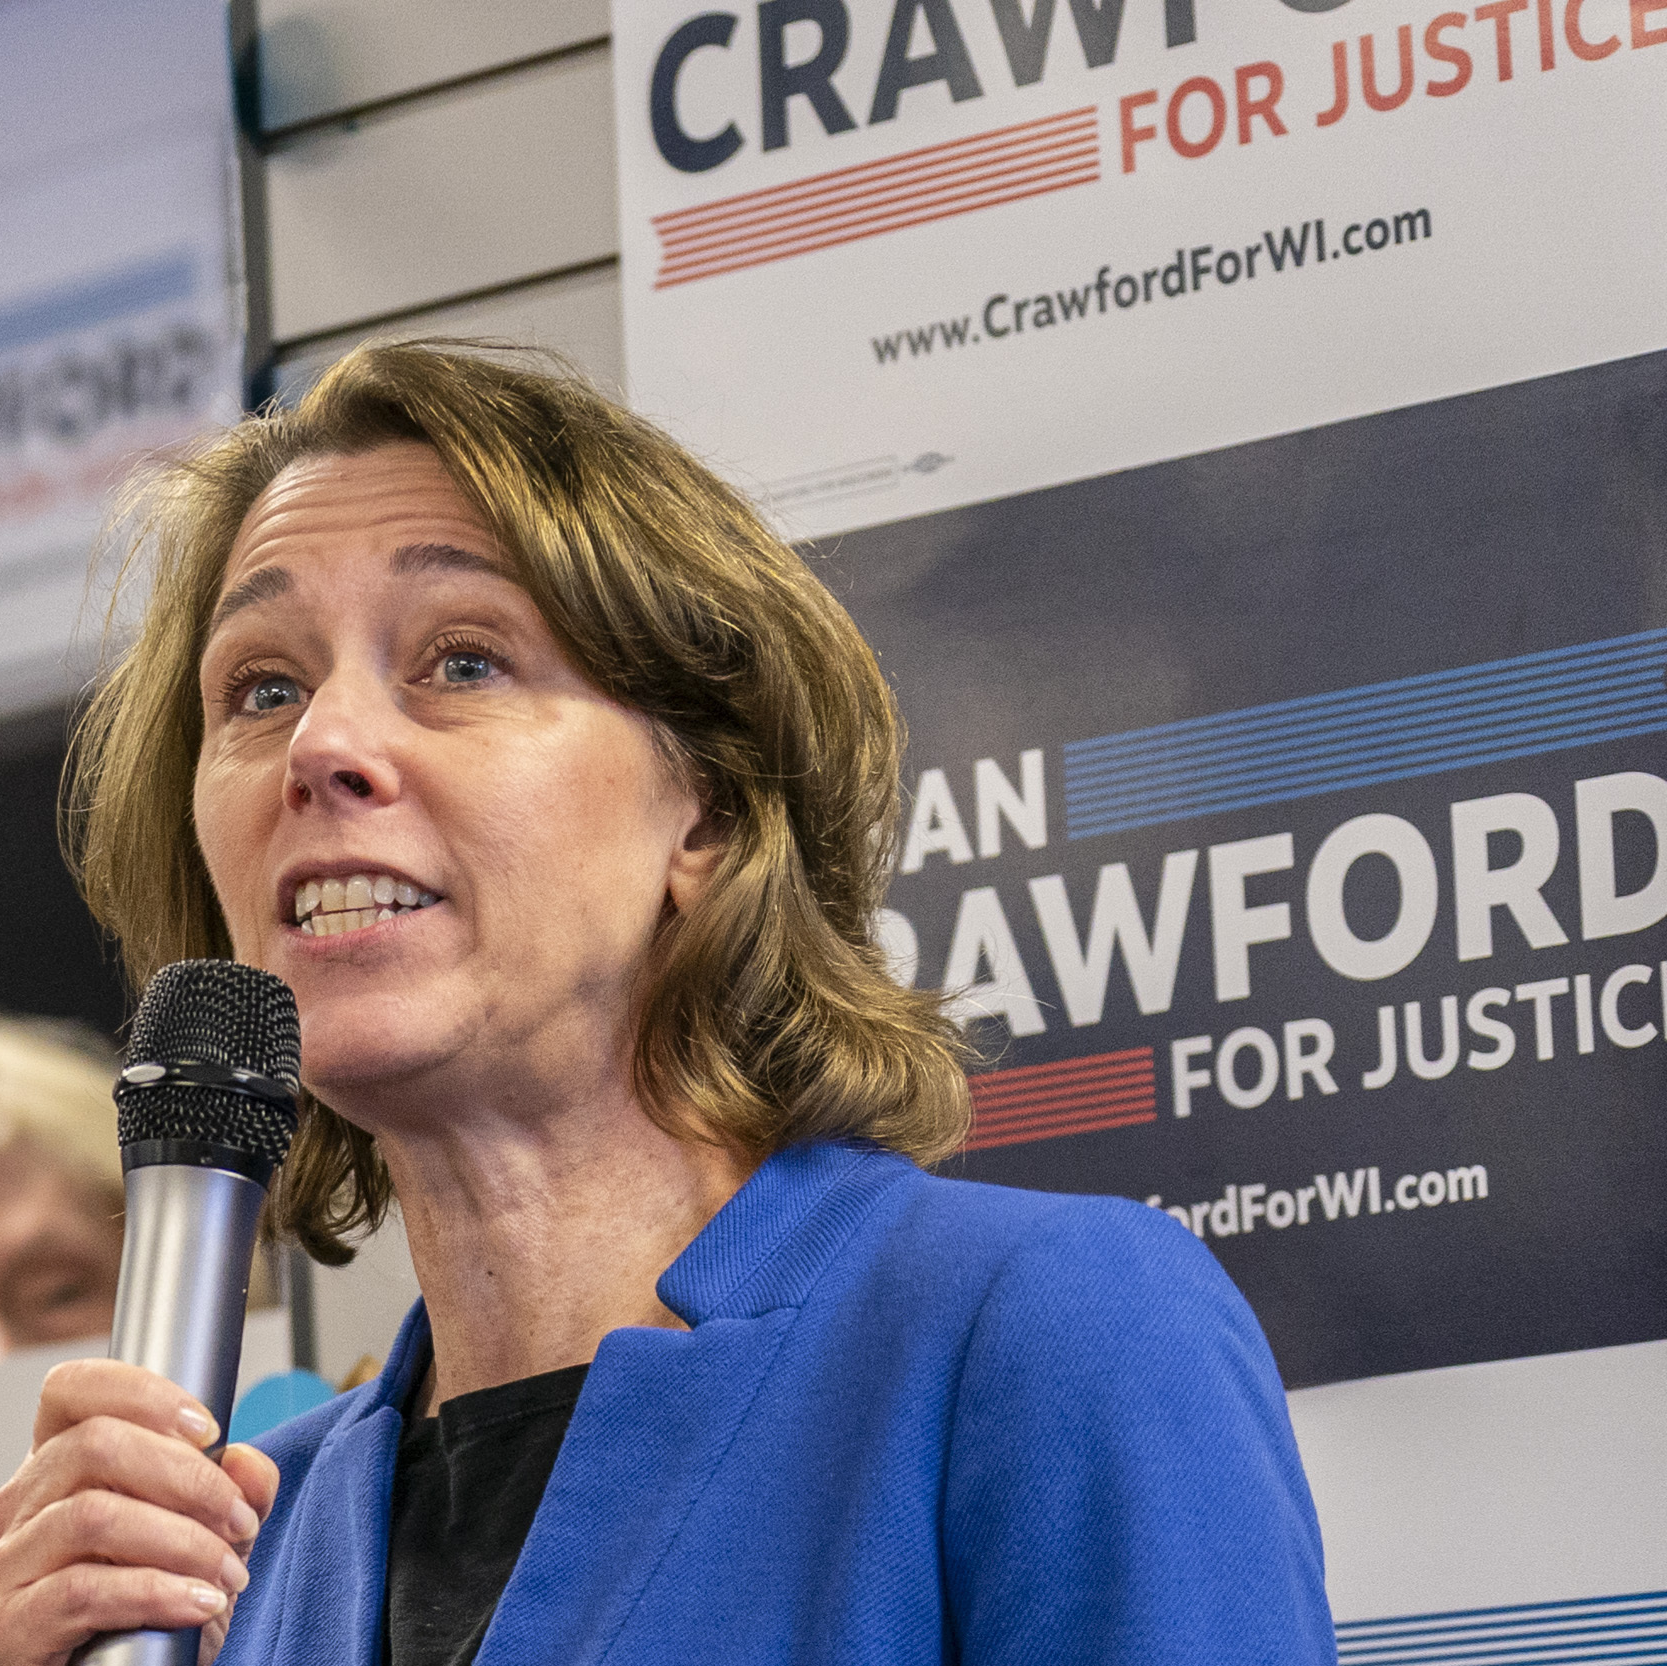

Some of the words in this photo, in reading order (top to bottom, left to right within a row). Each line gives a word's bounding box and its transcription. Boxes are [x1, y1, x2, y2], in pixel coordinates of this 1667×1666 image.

[649, 0, 1357, 174] CRAW
[1119, 62, 1289, 174] FOR
[871, 205, 1433, 366] www.CrawfordForWI.com
[870, 748, 1048, 875] AN
[1170, 1018, 1339, 1118] FOR
[1363, 963, 1667, 1090] JUSTIC
